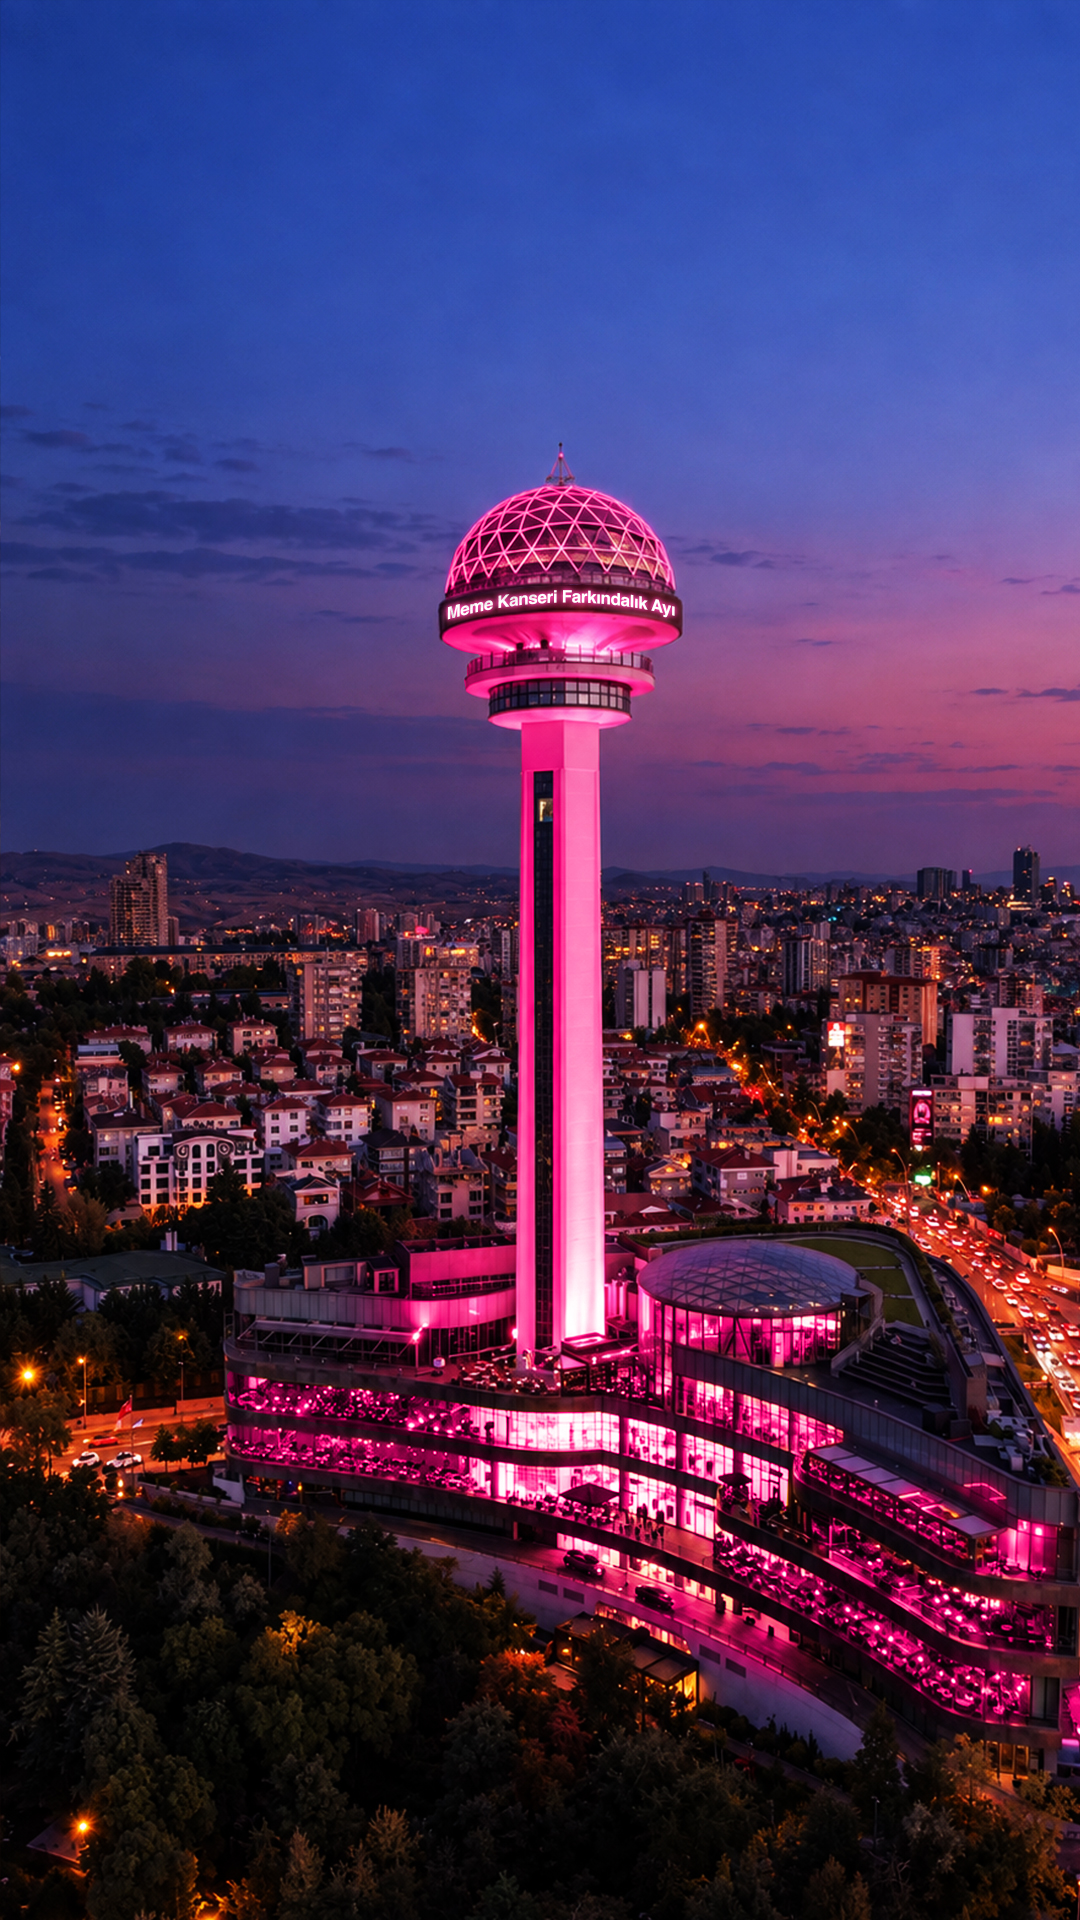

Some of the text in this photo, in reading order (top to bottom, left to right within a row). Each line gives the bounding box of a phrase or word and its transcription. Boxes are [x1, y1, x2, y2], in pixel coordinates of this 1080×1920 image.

[447, 590, 676, 620] Meme Kanseri Farkındalık Ayı
